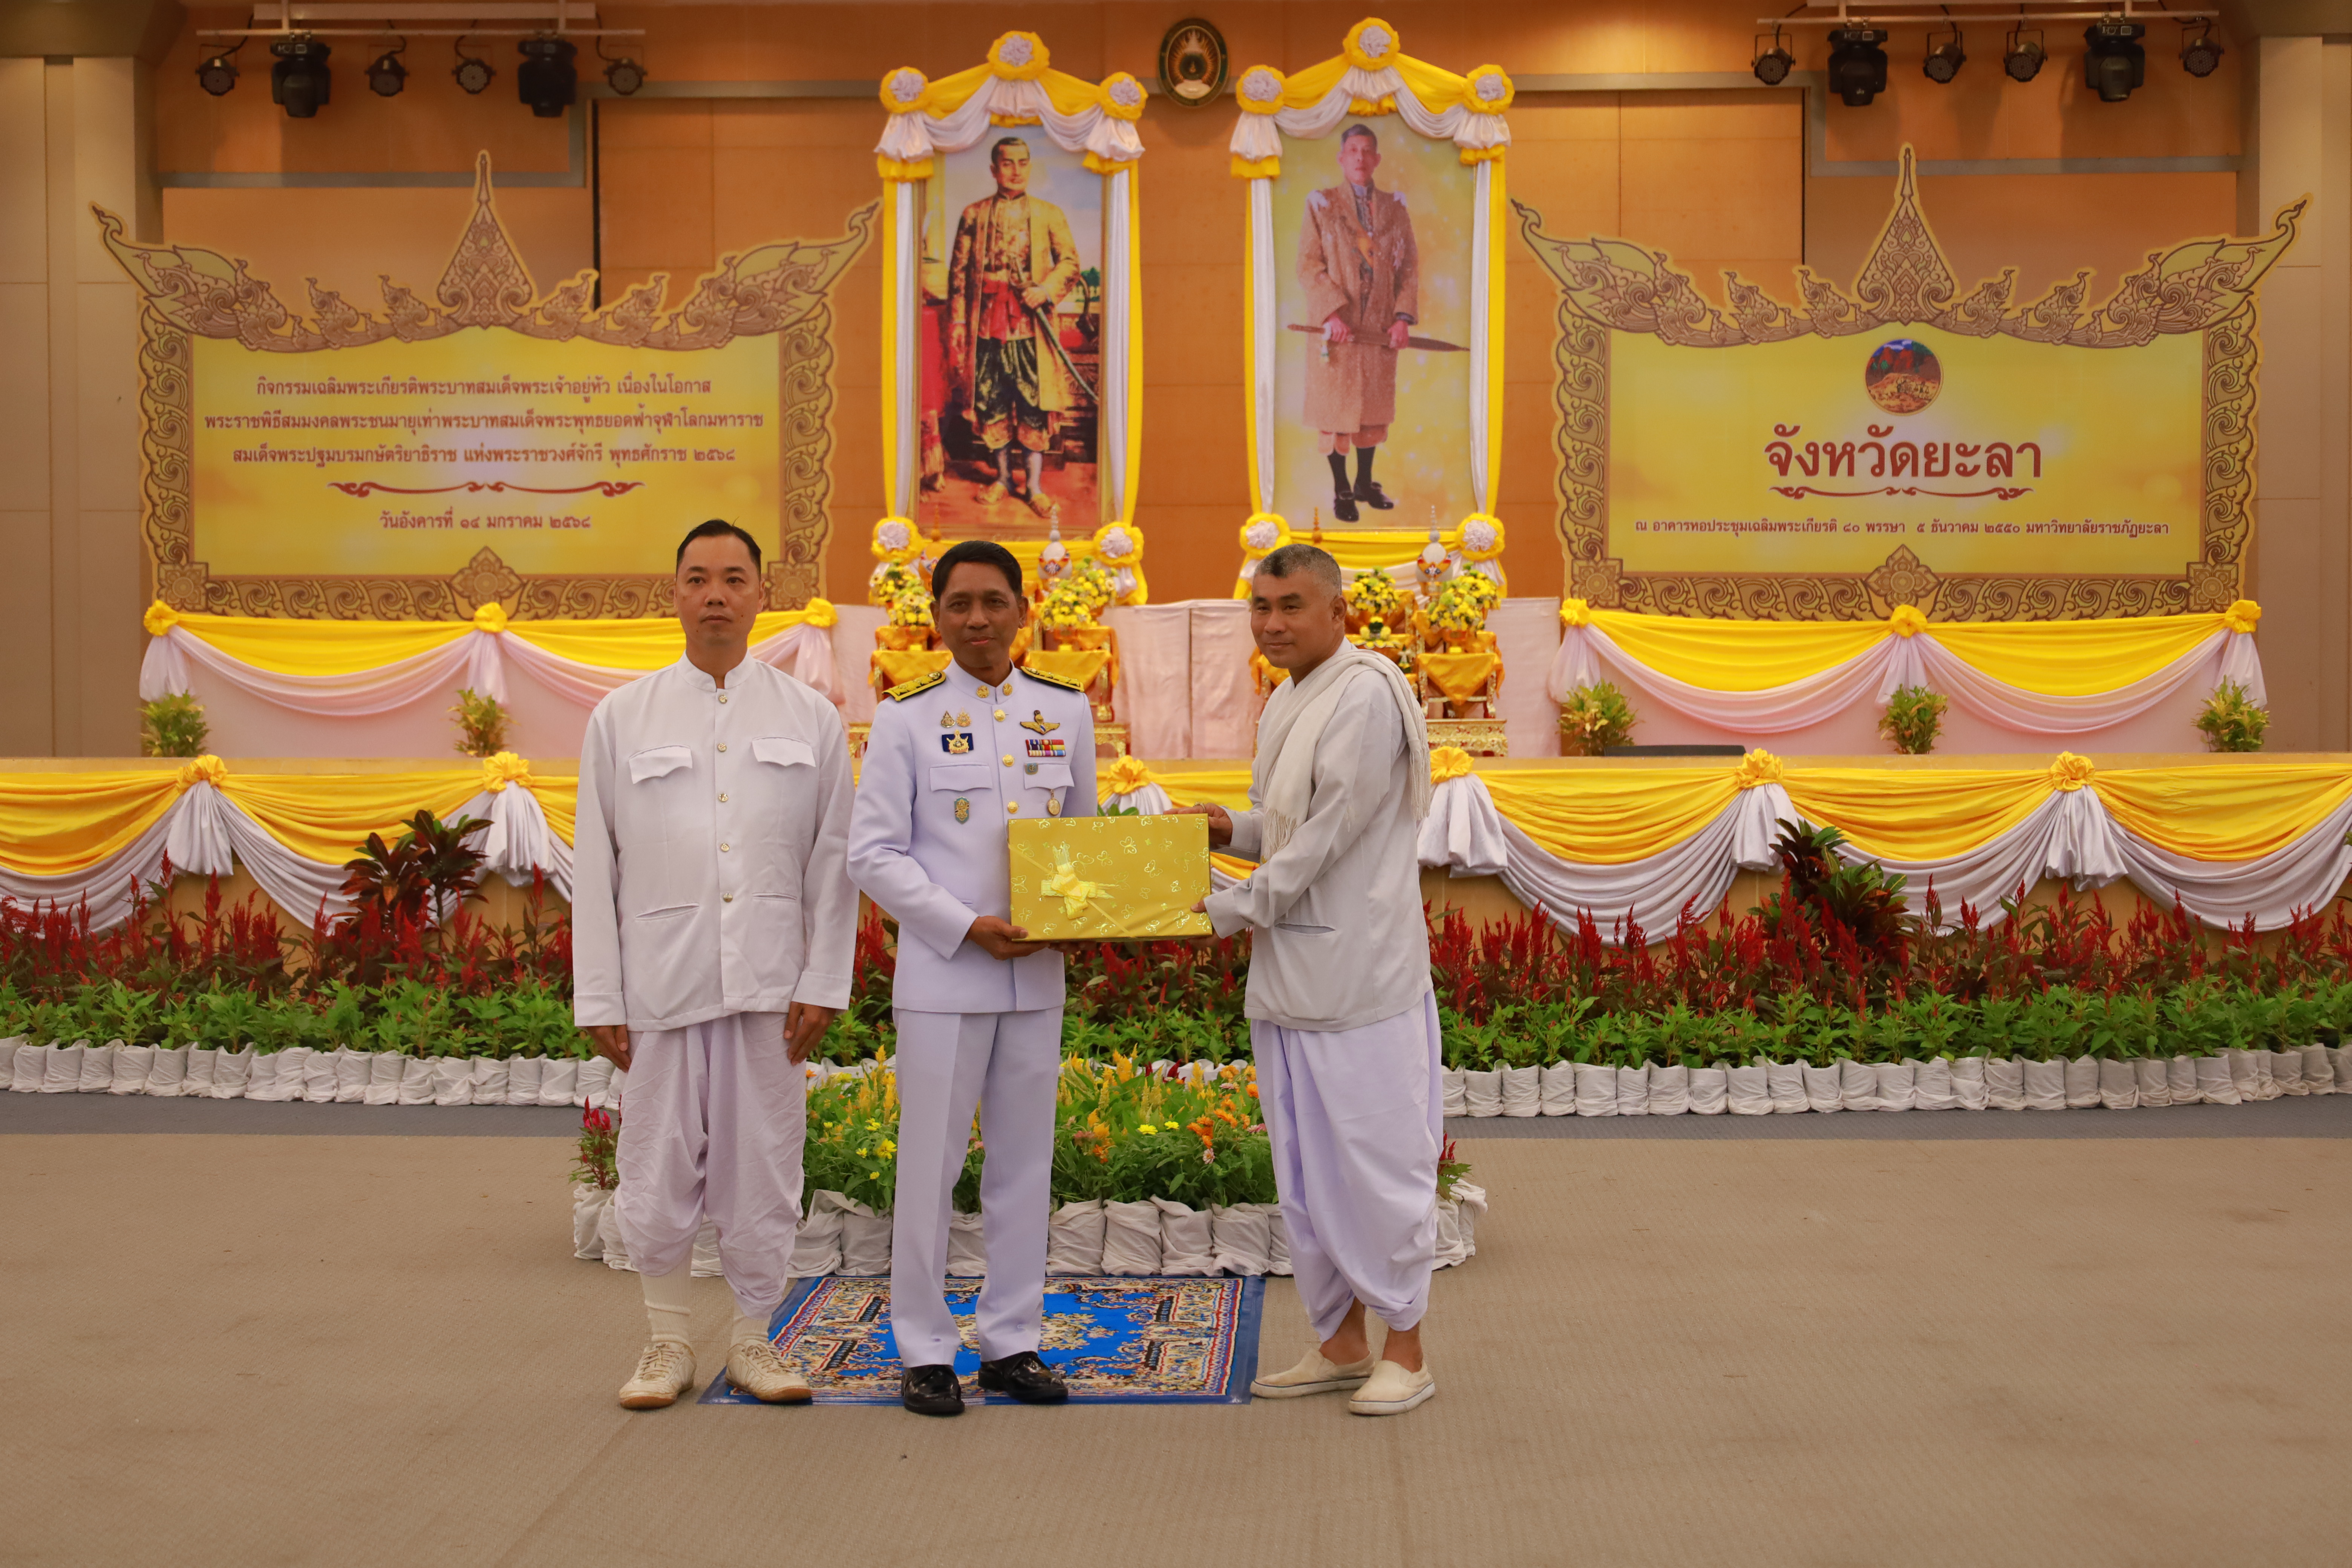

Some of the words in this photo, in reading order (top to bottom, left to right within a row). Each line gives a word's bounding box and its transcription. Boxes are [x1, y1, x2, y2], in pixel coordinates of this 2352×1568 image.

[257, 374, 611, 404] กิจกรรมเฉลิมพระเกียรติพระบาทสมเด็จพระเจ้าอยู่หัว
[617, 371, 712, 394] เนื่องในโอกาส
[464, 442, 603, 462] แห่งพระราชวงศ์จักรี
[609, 443, 687, 468] พุทธศักราช
[693, 449, 736, 462] ๒๕๖๘
[1764, 423, 2041, 478] จังหวัดยะลา
[379, 506, 453, 529] วันอังคารที่
[459, 516, 481, 530] ๑๔
[486, 515, 543, 529] มกราคม
[549, 516, 591, 529] ๒๕๖๘
[1635, 521, 1648, 531] ณ
[1652, 517, 1838, 537] อาคารหอประชุมเฉลิมพระเกียรติ
[1842, 522, 1860, 533] ๘๐
[1865, 522, 1906, 533] พรรษา
[1916, 522, 1926, 533] ๕
[1931, 518, 1979, 533] ธันวาคม
[1984, 522, 2021, 534] ๒๕๕๐
[2026, 518, 2169, 539] มหาวิทยาลัยราชภัฏยะลา
